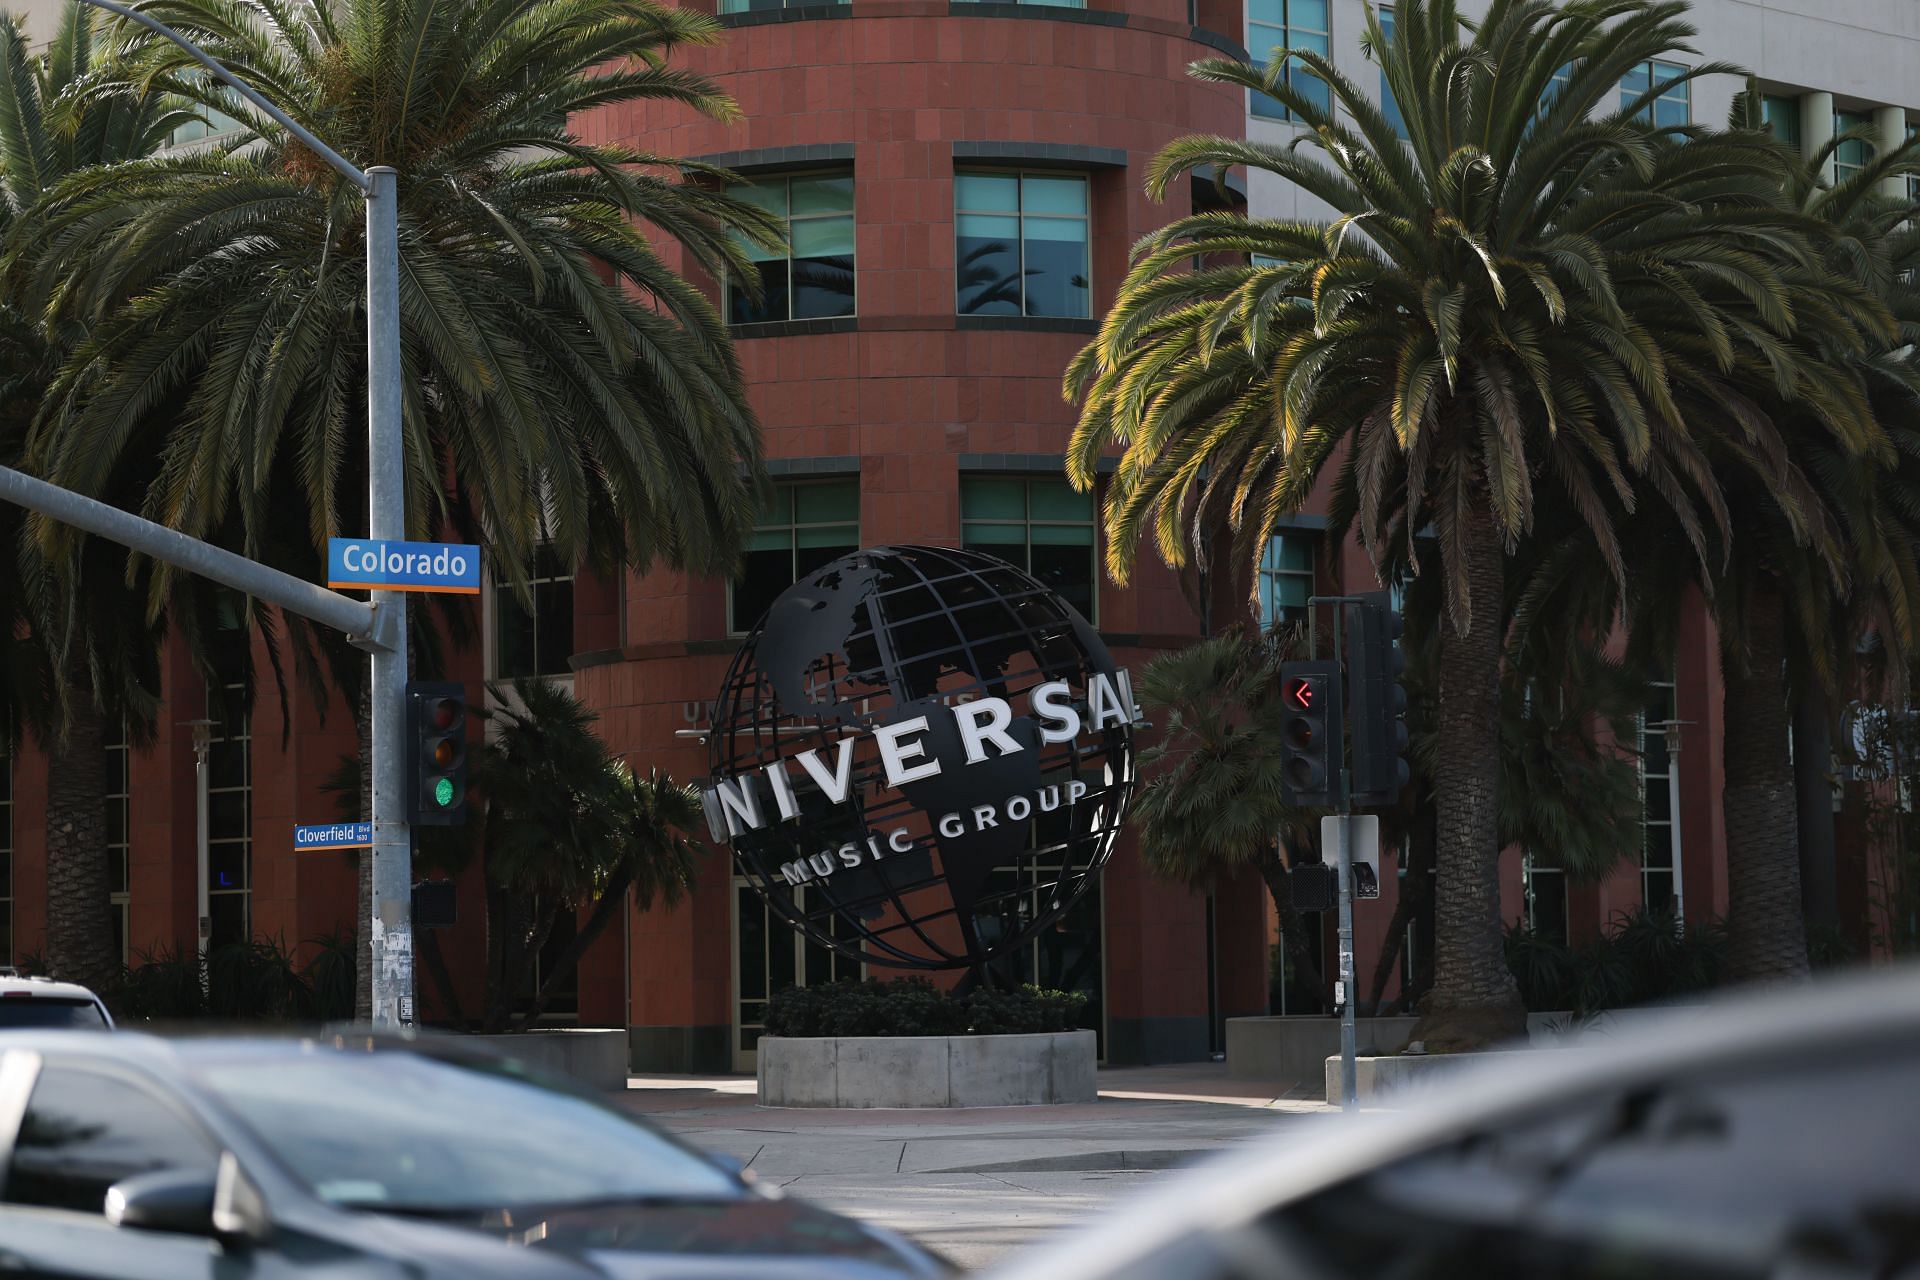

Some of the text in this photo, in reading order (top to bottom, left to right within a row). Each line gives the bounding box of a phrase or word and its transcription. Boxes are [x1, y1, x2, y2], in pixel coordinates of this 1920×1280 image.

[343, 544, 467, 576] Colorado
[297, 825, 354, 842] Cloverfield
[780, 779, 1087, 887] MUSIC GROUP
